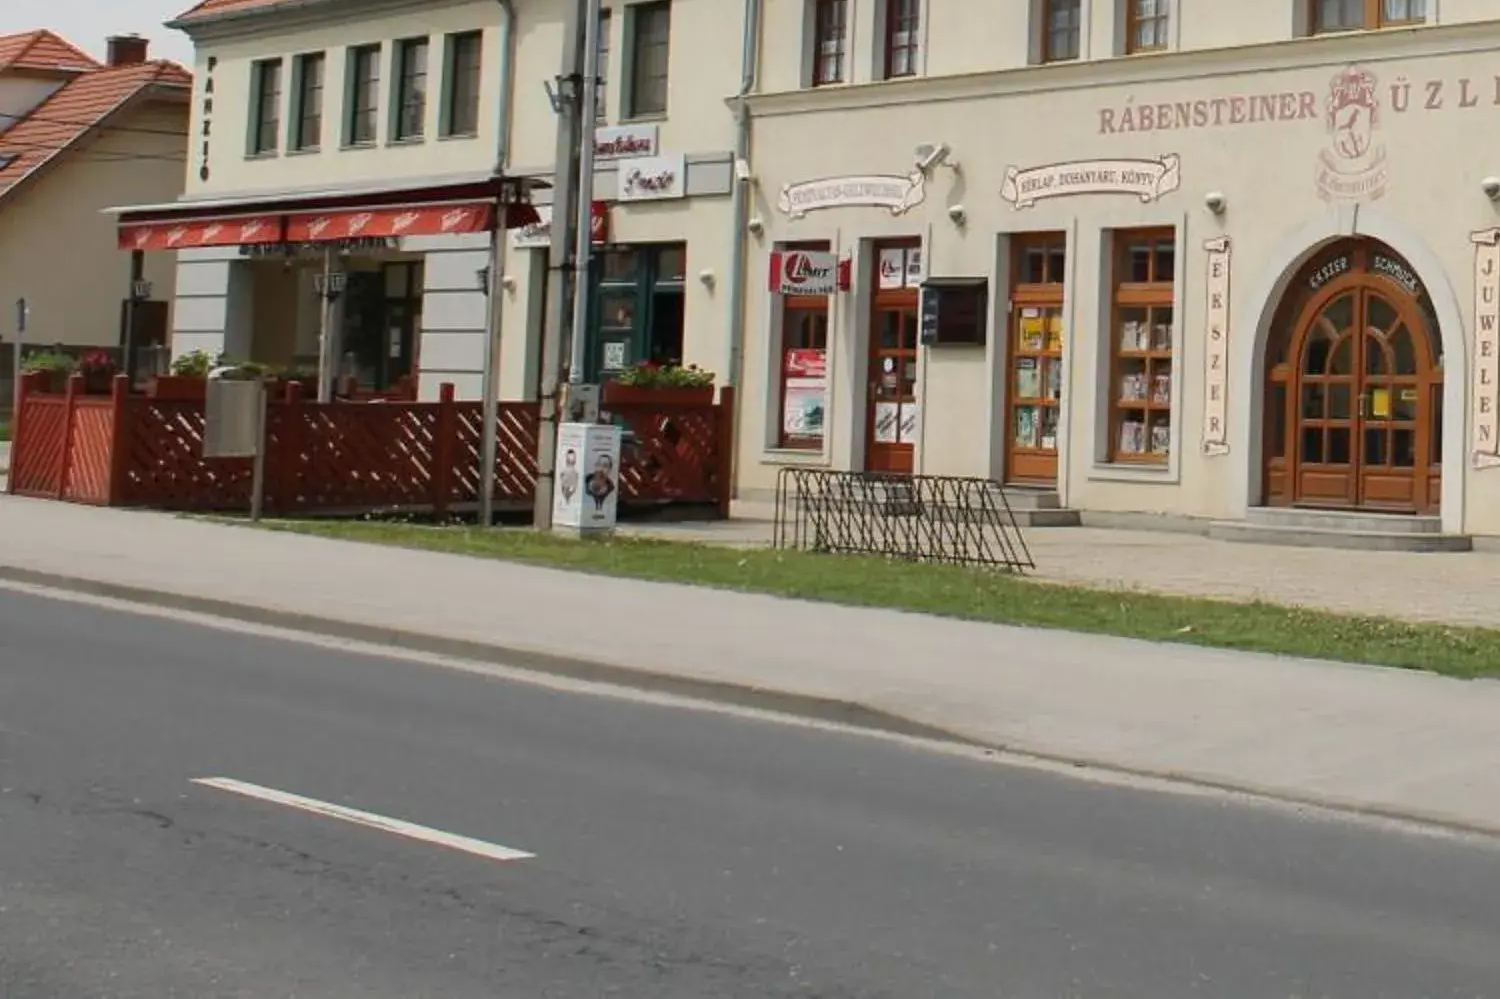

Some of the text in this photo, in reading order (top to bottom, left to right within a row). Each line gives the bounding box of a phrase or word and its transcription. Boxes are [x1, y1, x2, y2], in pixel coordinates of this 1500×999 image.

[199, 56, 217, 183] PANZIÓ
[1098, 91, 1318, 135] RÁBENSTEINER
[1478, 257, 1496, 442] JUWELEN
